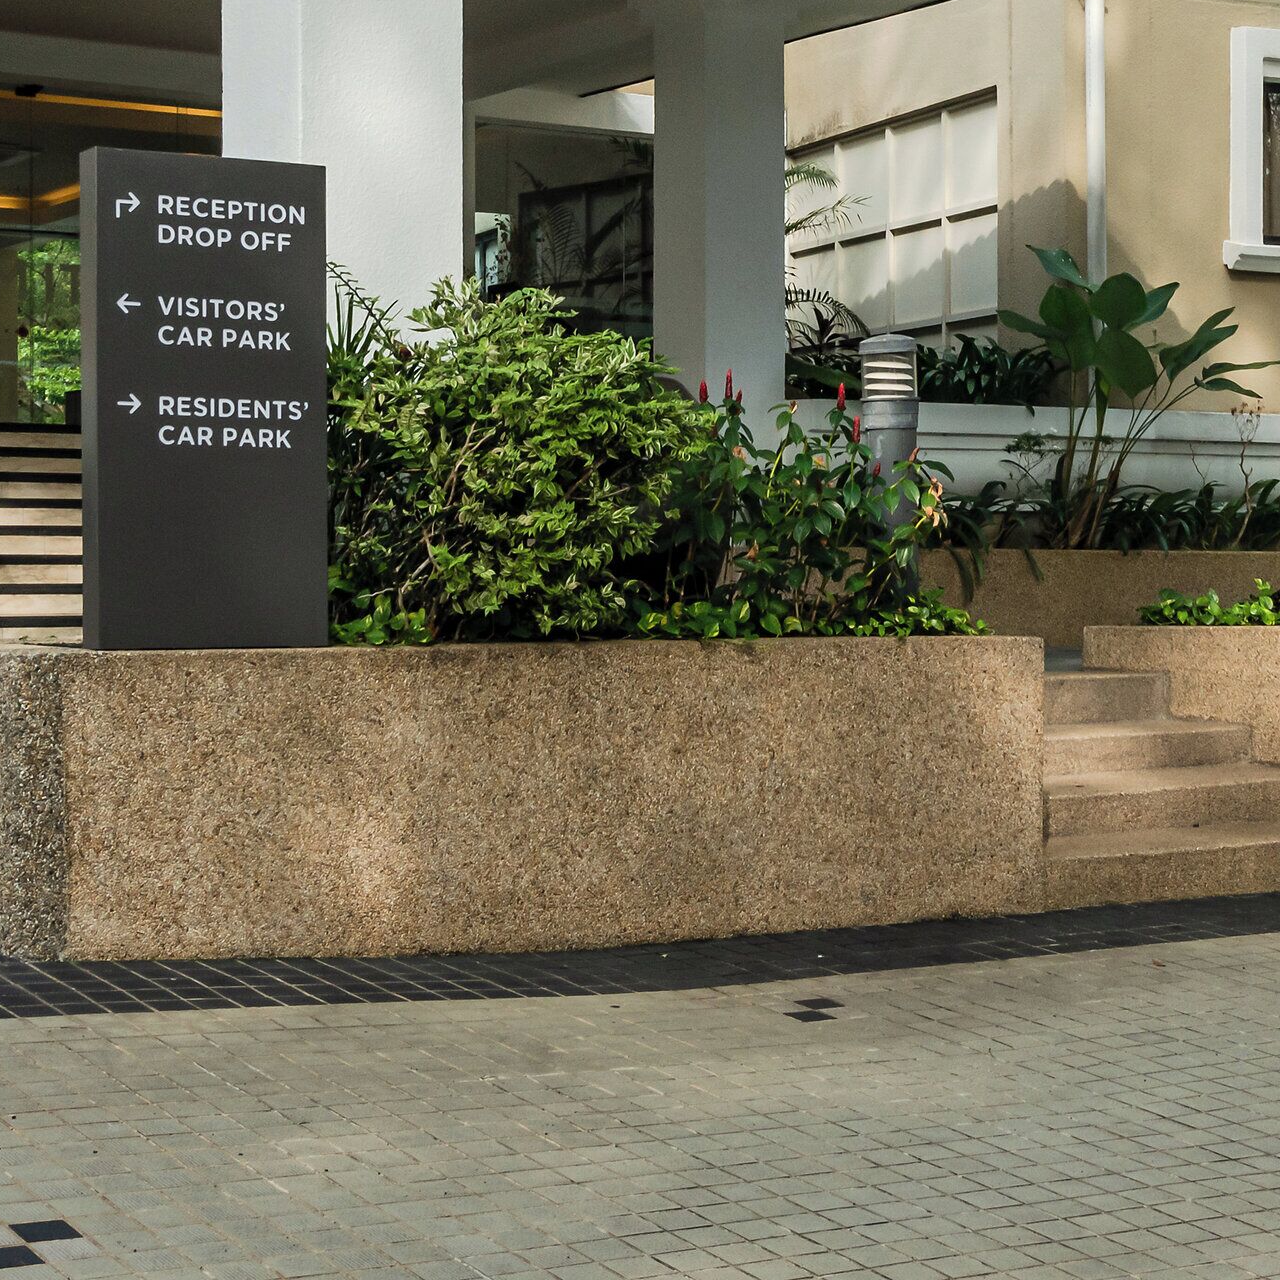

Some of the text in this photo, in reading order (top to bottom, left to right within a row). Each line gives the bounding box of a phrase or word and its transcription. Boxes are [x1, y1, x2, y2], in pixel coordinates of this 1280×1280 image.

[157, 194, 306, 226] RECEPTION
[157, 223, 292, 252] DROP OFF
[157, 295, 285, 322] VISITORS’
[157, 325, 292, 351] CAR PARK
[158, 395, 309, 421] RESIDENTS’
[158, 424, 292, 449] CAR PARK
